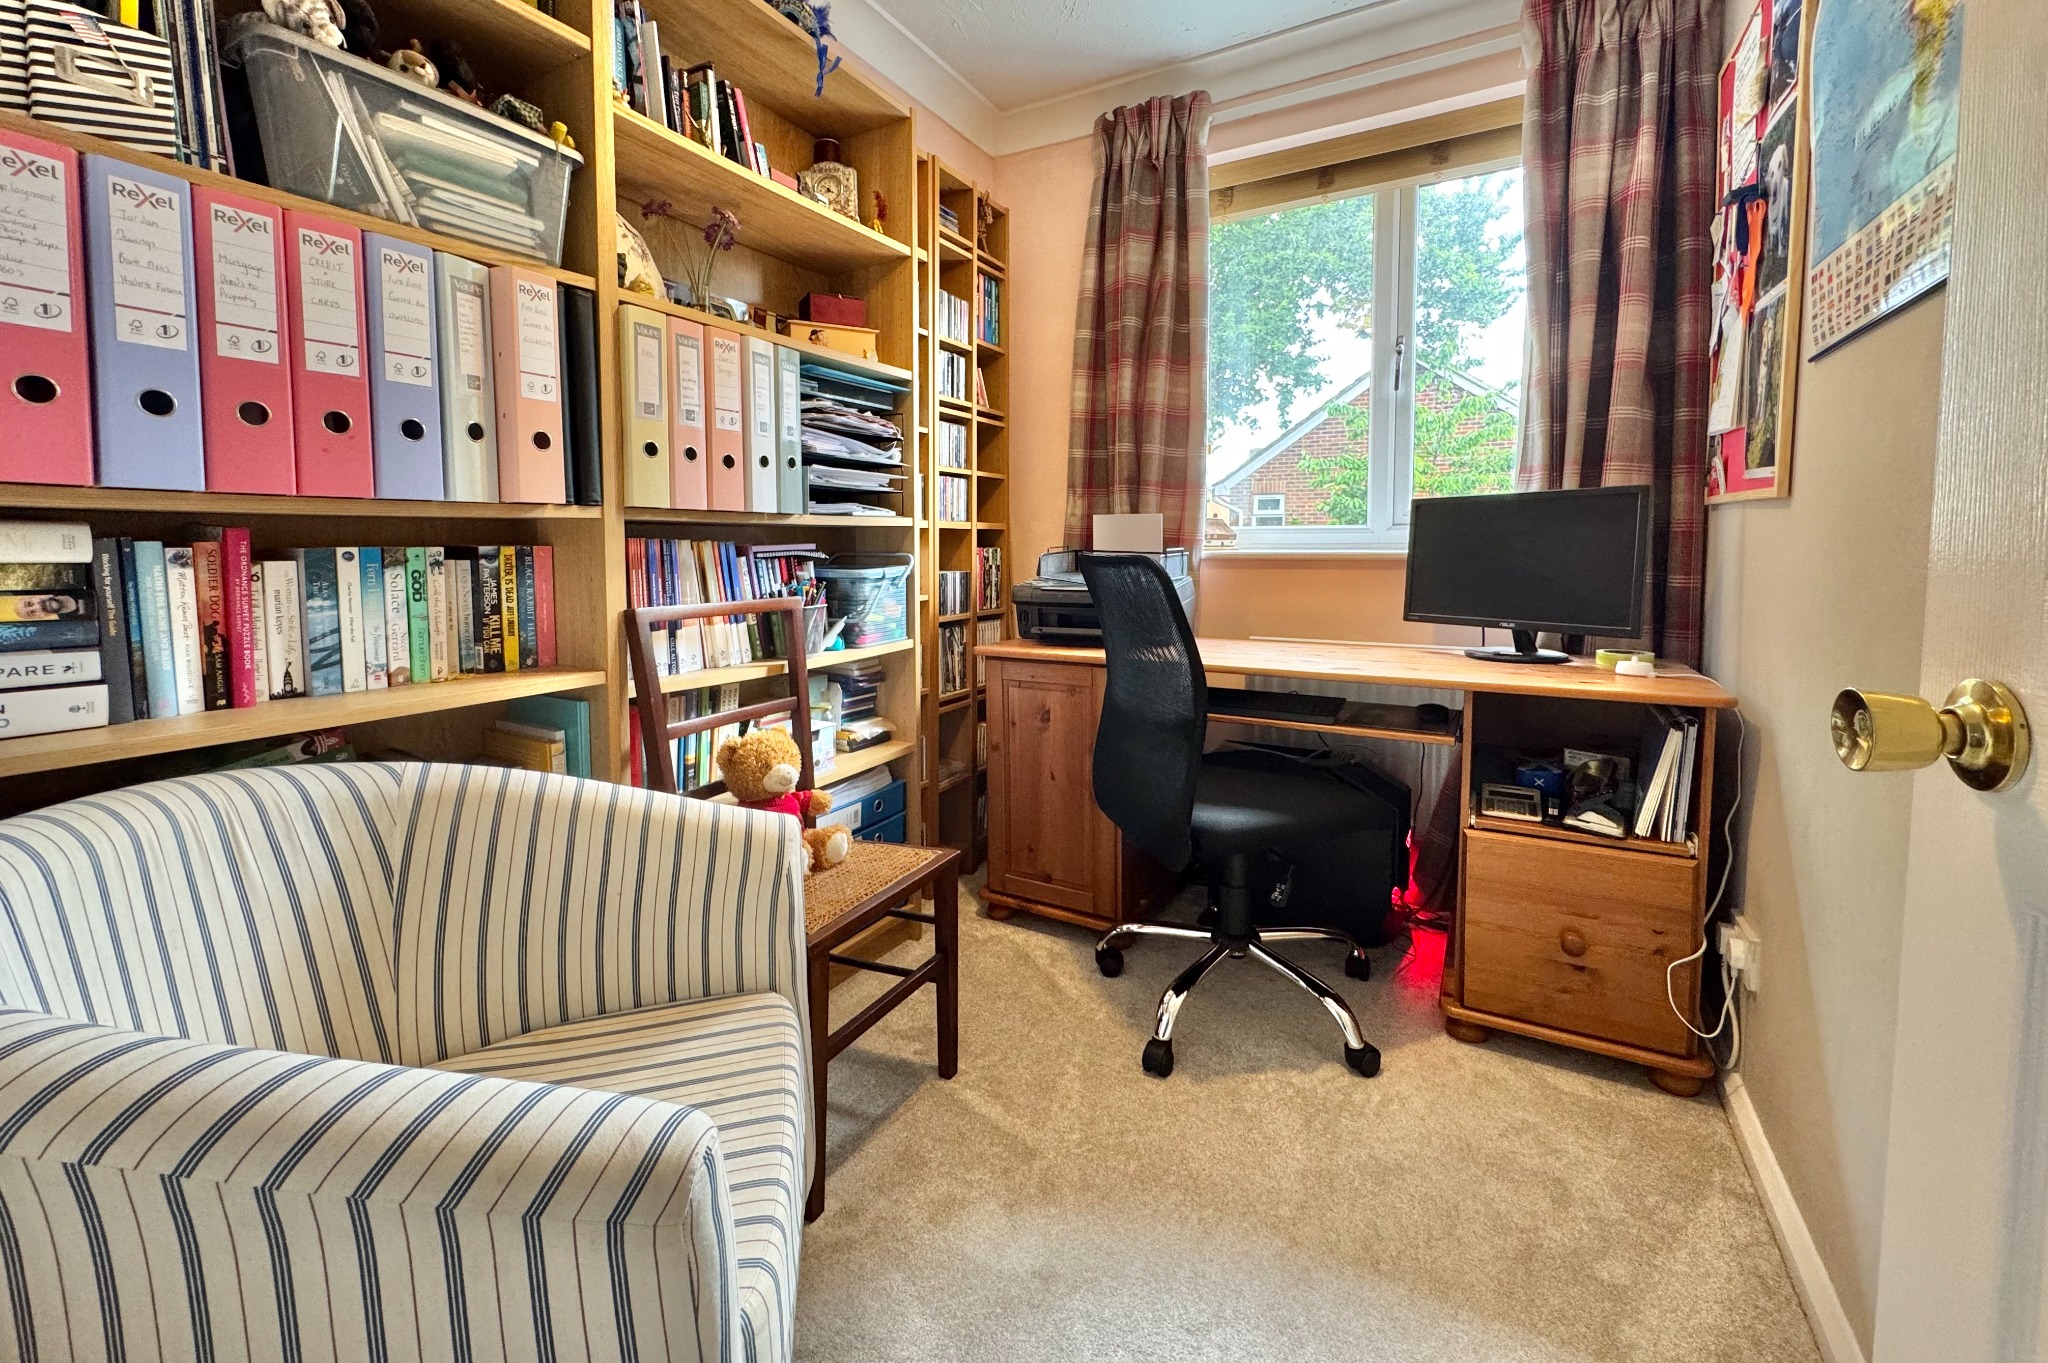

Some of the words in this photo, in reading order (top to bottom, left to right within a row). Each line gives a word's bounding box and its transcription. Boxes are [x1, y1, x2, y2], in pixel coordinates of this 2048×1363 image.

[0, 150, 60, 180] exel
[218, 252, 265, 279] Mortgage
[308, 256, 344, 272] CREDIT
[310, 276, 337, 289] STORE
[310, 297, 341, 309] CARDS
[239, 541, 247, 554] THE
[102, 553, 111, 576] Working
[207, 549, 219, 593] SOLDIER
[240, 556, 249, 595] ORDNANCE
[366, 563, 379, 586] Fern
[503, 553, 513, 577] DEXTER
[524, 556, 533, 586] BLACK
[105, 585, 115, 608] yourself
[285, 577, 294, 604] Woman
[390, 573, 404, 614] Solace
[411, 569, 422, 602] GOD
[482, 568, 491, 615] PATTERSON
[490, 577, 498, 604] JAMES
[505, 586, 514, 604] DEAD
[209, 594, 221, 619] DOG
[241, 597, 250, 621] SURVEY
[274, 589, 282, 615] marian
[525, 587, 535, 620] RABBIT
[243, 623, 251, 648] PUZZLE
[275, 615, 284, 636] keyes
[287, 615, 296, 633] Stole
[489, 614, 501, 637] KILL
[527, 621, 536, 646] HALL
[287, 640, 297, 656] Life
[391, 623, 402, 662] Gerrard
[400, 632, 408, 651] Nicci
[490, 637, 501, 654] ME
[216, 669, 225, 693] ANGUS
